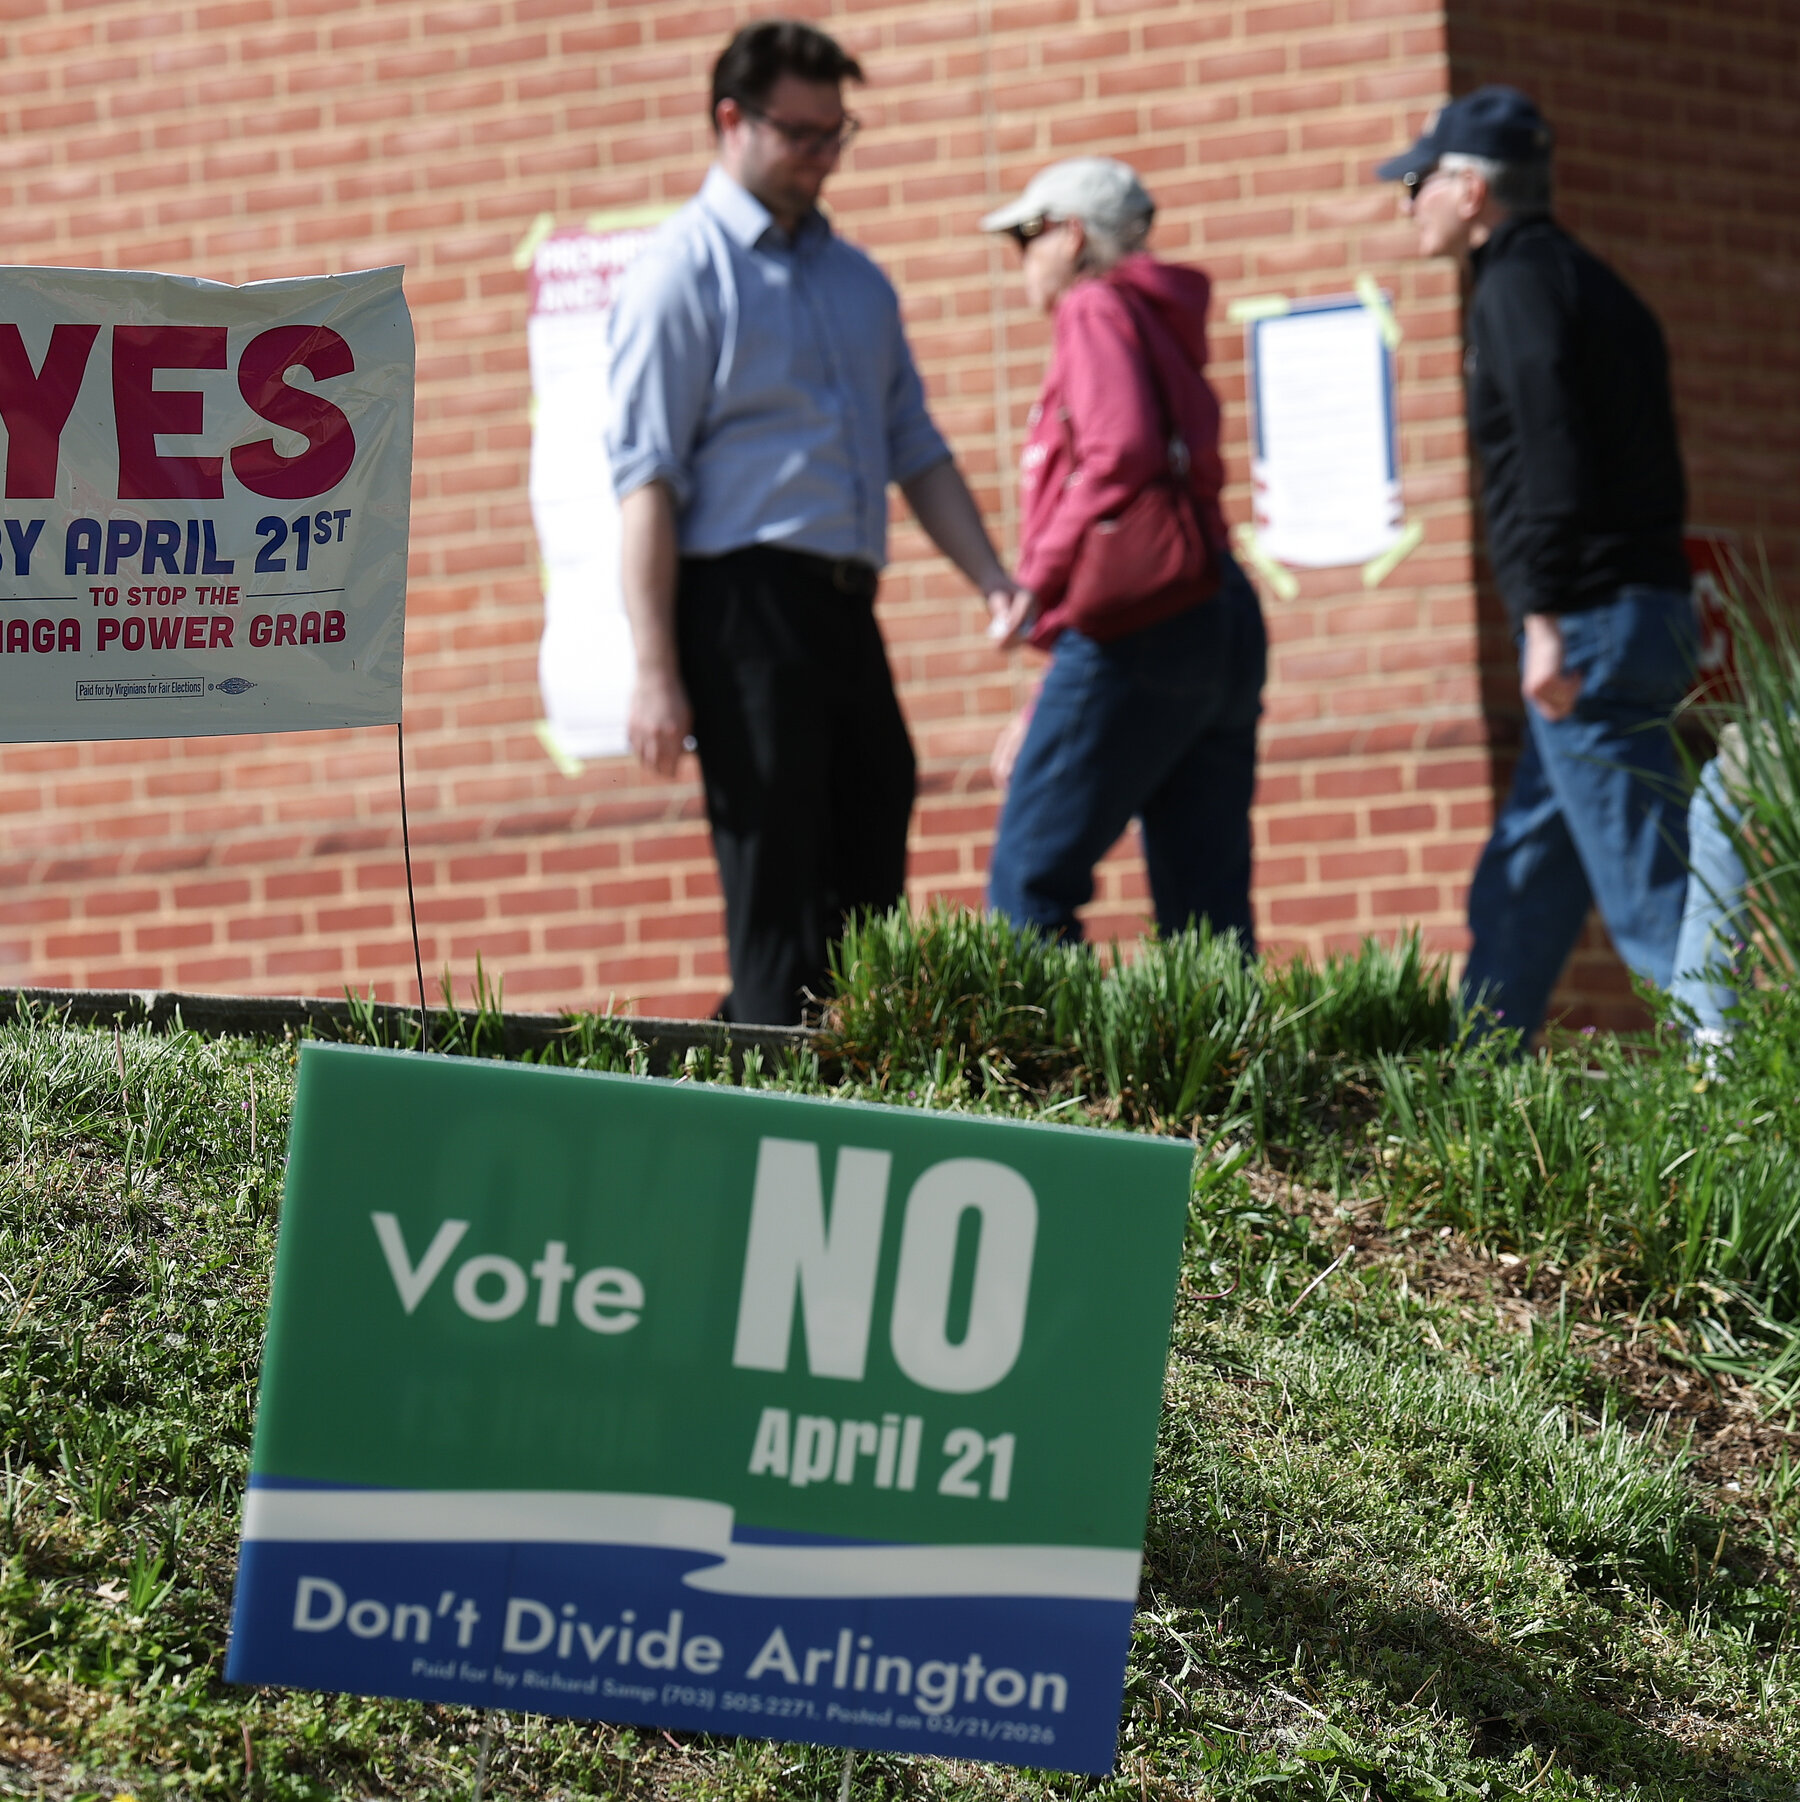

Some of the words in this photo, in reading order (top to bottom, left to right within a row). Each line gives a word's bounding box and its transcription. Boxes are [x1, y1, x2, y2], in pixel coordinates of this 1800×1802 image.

[0, 324, 356, 500] YES
[0, 520, 46, 576] Y
[65, 518, 235, 576] APRIL
[255, 509, 352, 574] 21ST
[0, 618, 81, 654] AGA
[98, 616, 235, 652] POWER
[249, 610, 347, 648] GRAB
[88, 587, 119, 607] TO
[126, 586, 187, 606] STOP
[195, 586, 241, 606] THE
[79, 683, 94, 696] Paid
[95, 683, 105, 695] for
[105, 683, 114, 697] by
[114, 683, 147, 697] Virginians
[147, 682, 158, 694] for
[158, 681, 171, 694] Fair
[171, 681, 202, 693] Elections
[371, 1212, 645, 1335] Vote
[733, 1137, 1039, 1393] NO
[748, 1407, 923, 1490] April
[938, 1427, 1017, 1501] 21
[292, 1576, 480, 1648] Don't
[502, 1598, 724, 1675] Divide
[746, 1625, 1068, 1717] Arlington
[411, 1657, 457, 1681] Paid
[459, 1660, 488, 1683] for
[493, 1662, 518, 1690] by
[522, 1668, 598, 1695] Richard
[602, 1677, 657, 1705] Samp
[661, 1683, 717, 1712] (703)
[826, 1701, 893, 1728] Posted
[895, 1712, 922, 1731] on
[926, 1711, 1056, 1746] 03/21/2026
